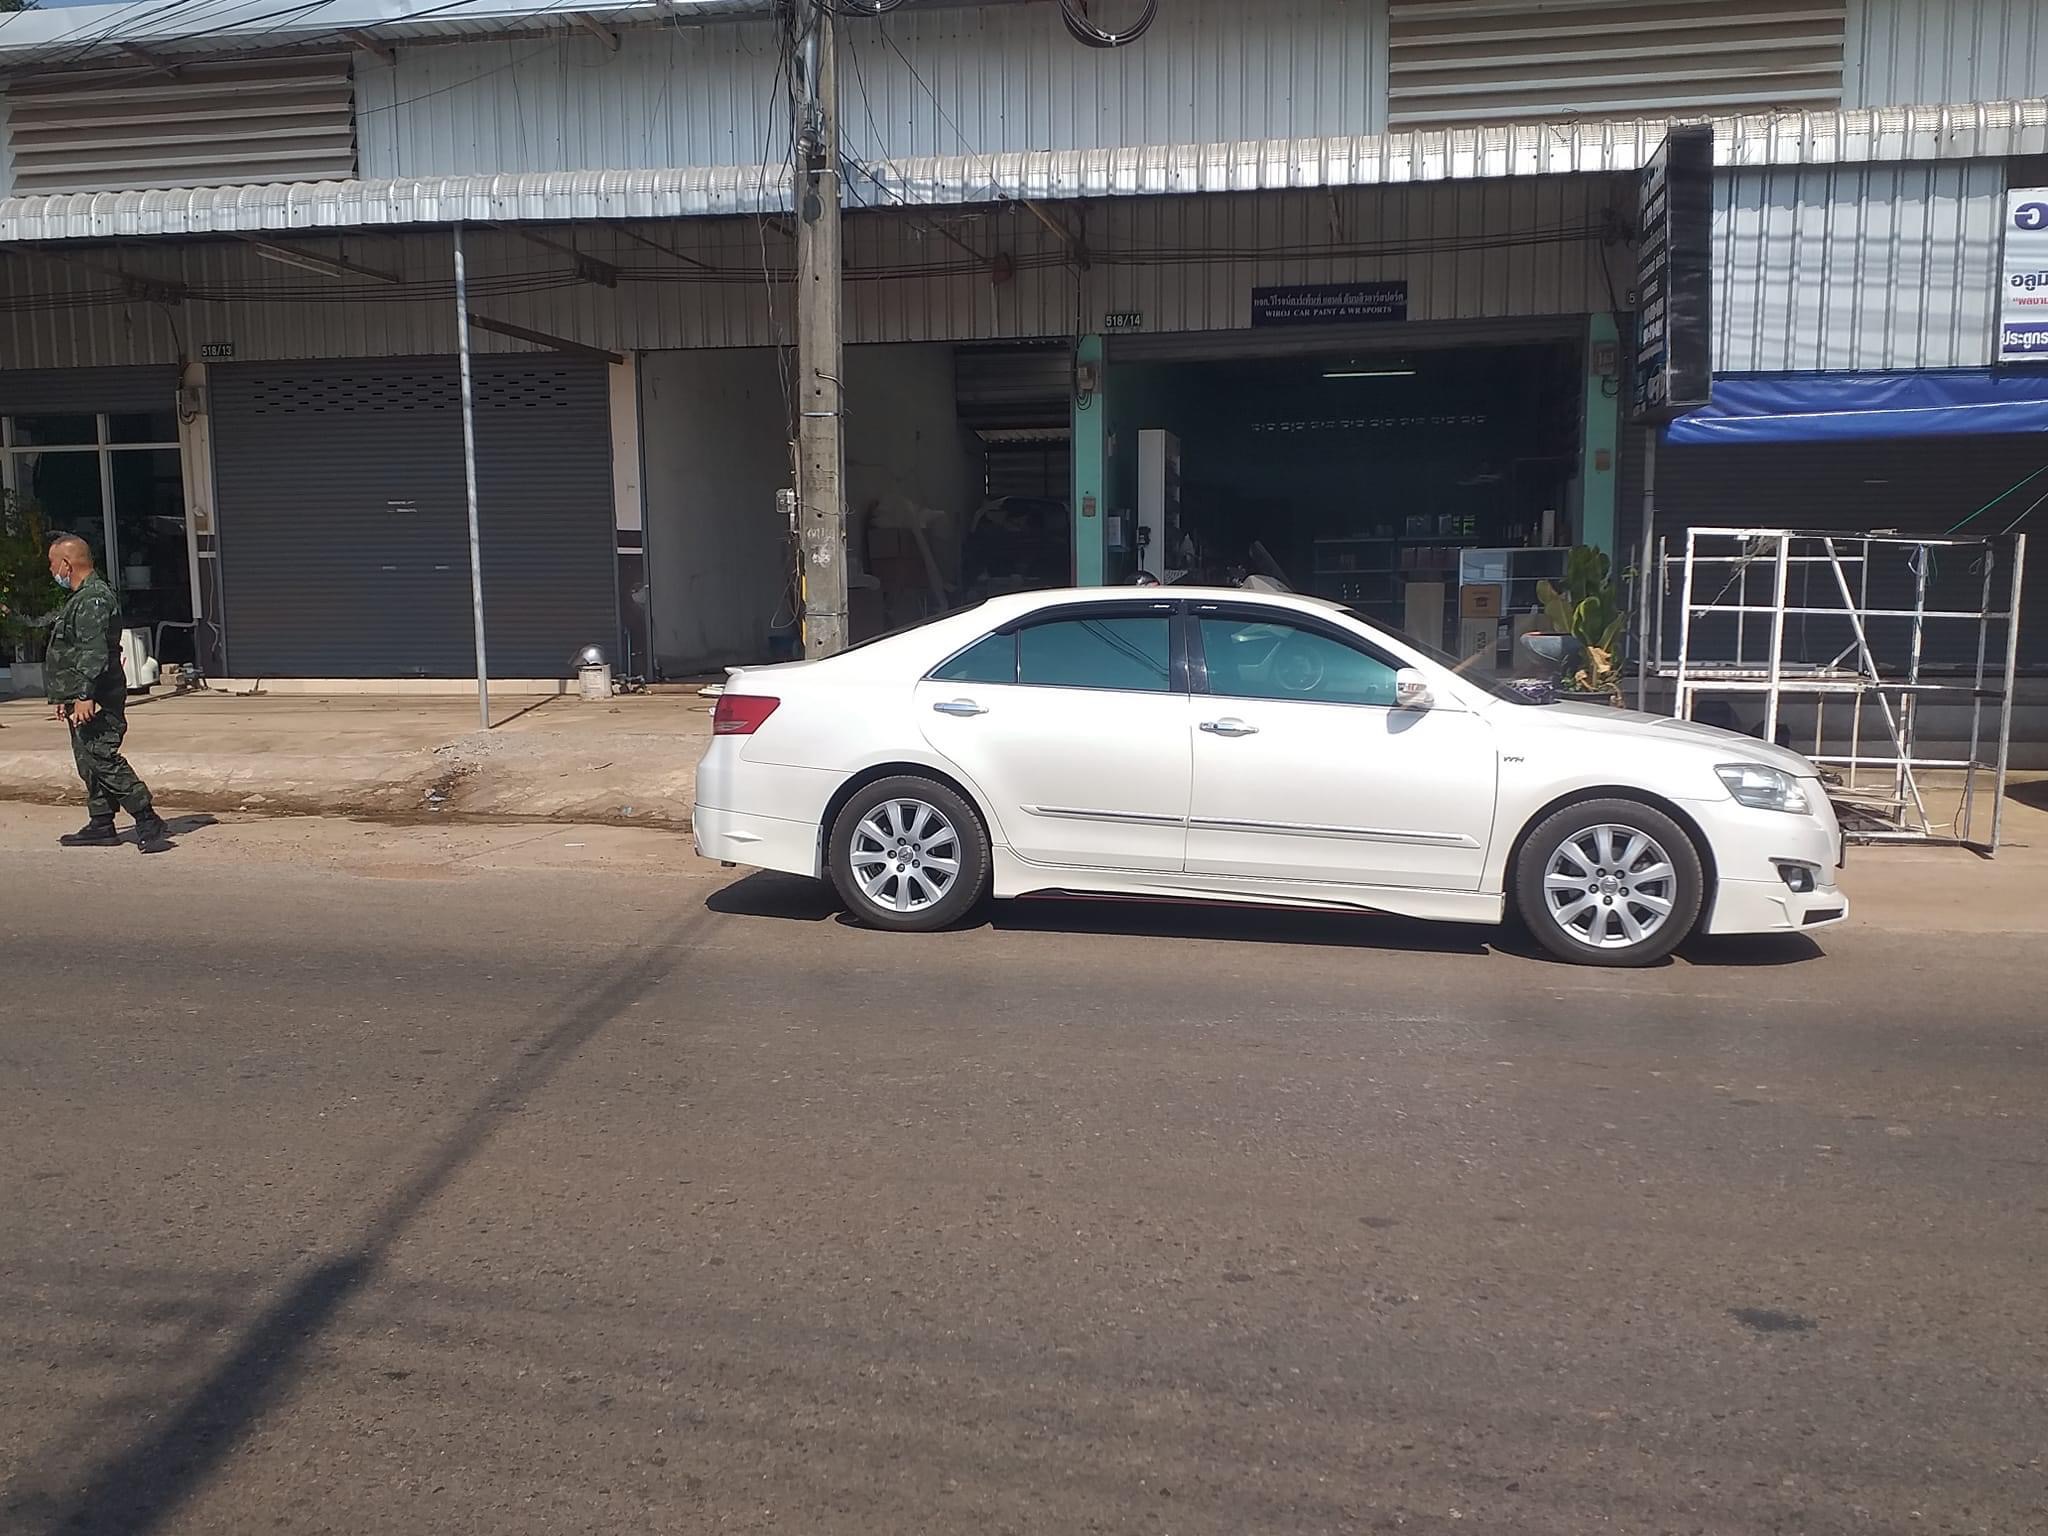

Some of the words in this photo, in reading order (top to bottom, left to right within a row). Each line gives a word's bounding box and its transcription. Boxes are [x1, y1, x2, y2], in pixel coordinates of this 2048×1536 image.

[1293, 308, 1310, 316] CAR
[1313, 307, 1337, 315] PAINT
[1339, 307, 1346, 315] &
[1106, 314, 1140, 327] 518/14
[202, 345, 232, 356] 518/13
